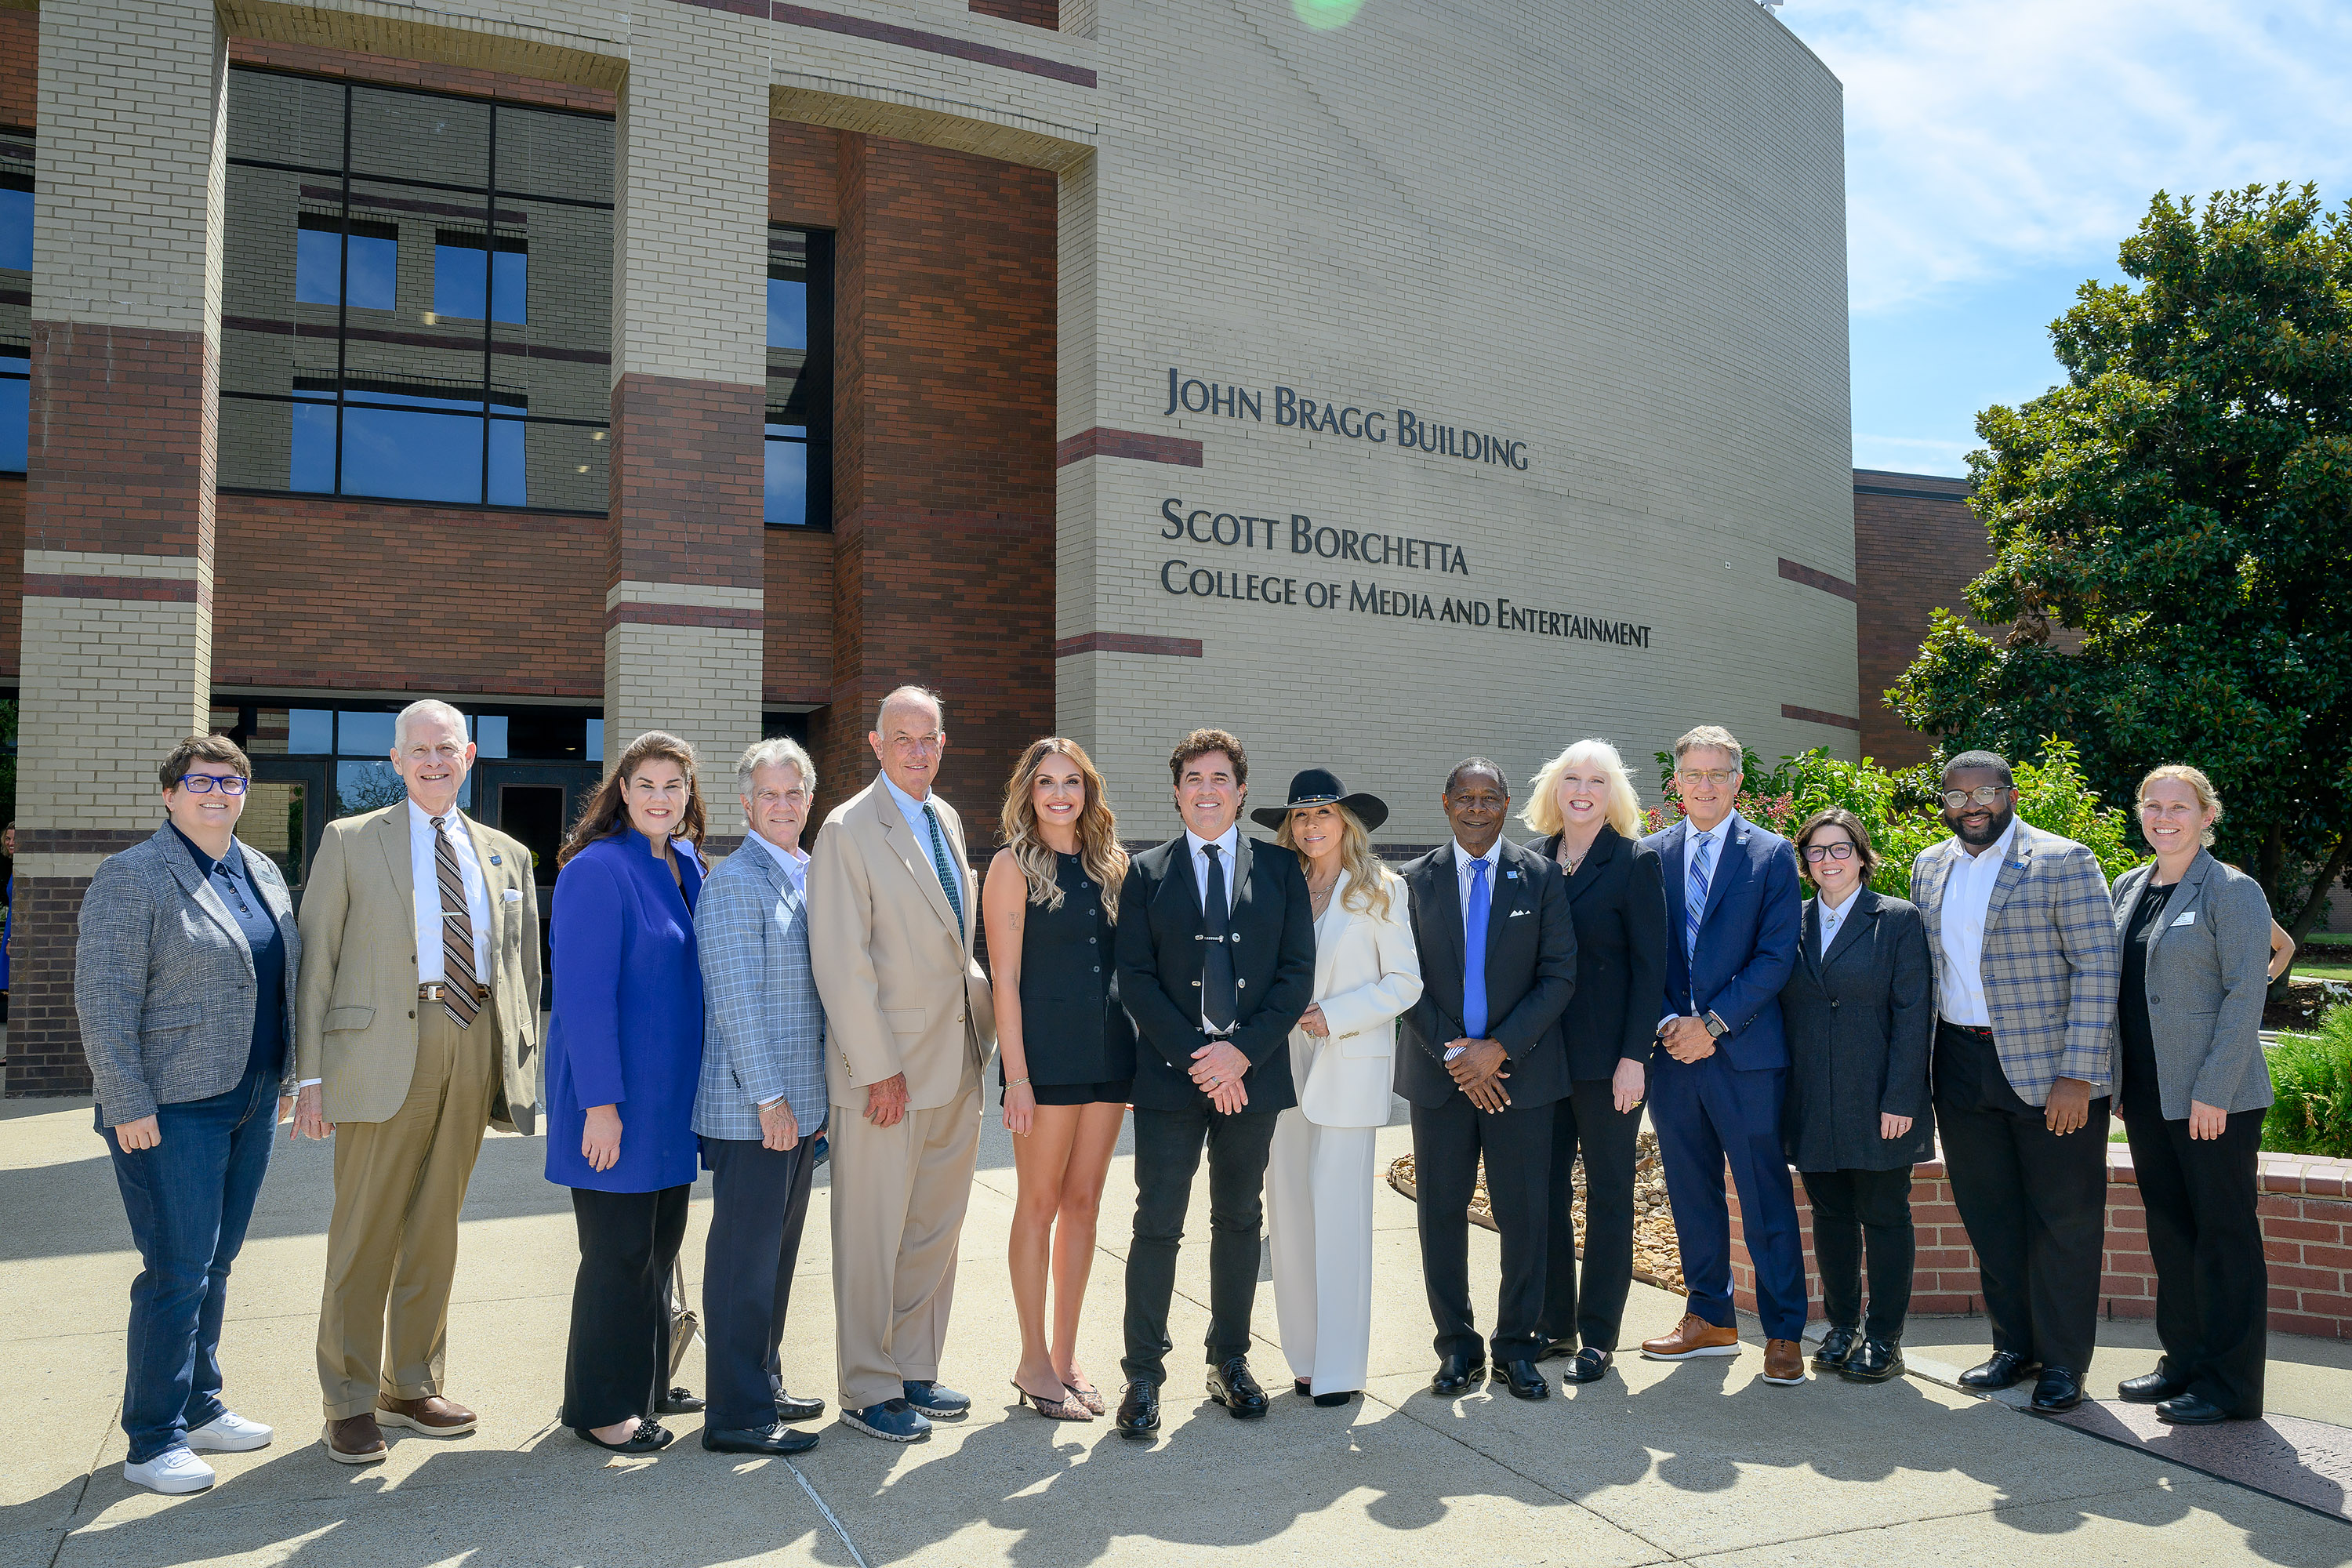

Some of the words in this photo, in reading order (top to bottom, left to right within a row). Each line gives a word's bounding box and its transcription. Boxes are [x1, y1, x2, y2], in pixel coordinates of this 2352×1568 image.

[1163, 367, 1261, 423] JOHN
[1275, 385, 1387, 443] BRAGG
[1397, 408, 1528, 471] BUILDING
[1160, 498, 1280, 550] SCOTT
[1290, 514, 1469, 575] BORCHETTA
[1160, 559, 1297, 605] COLLEGE
[1305, 582, 1341, 610] OF
[1348, 579, 1436, 621] MEDIA
[1439, 597, 1490, 626] AND
[1497, 597, 1652, 649] ENTERTAINMENT
